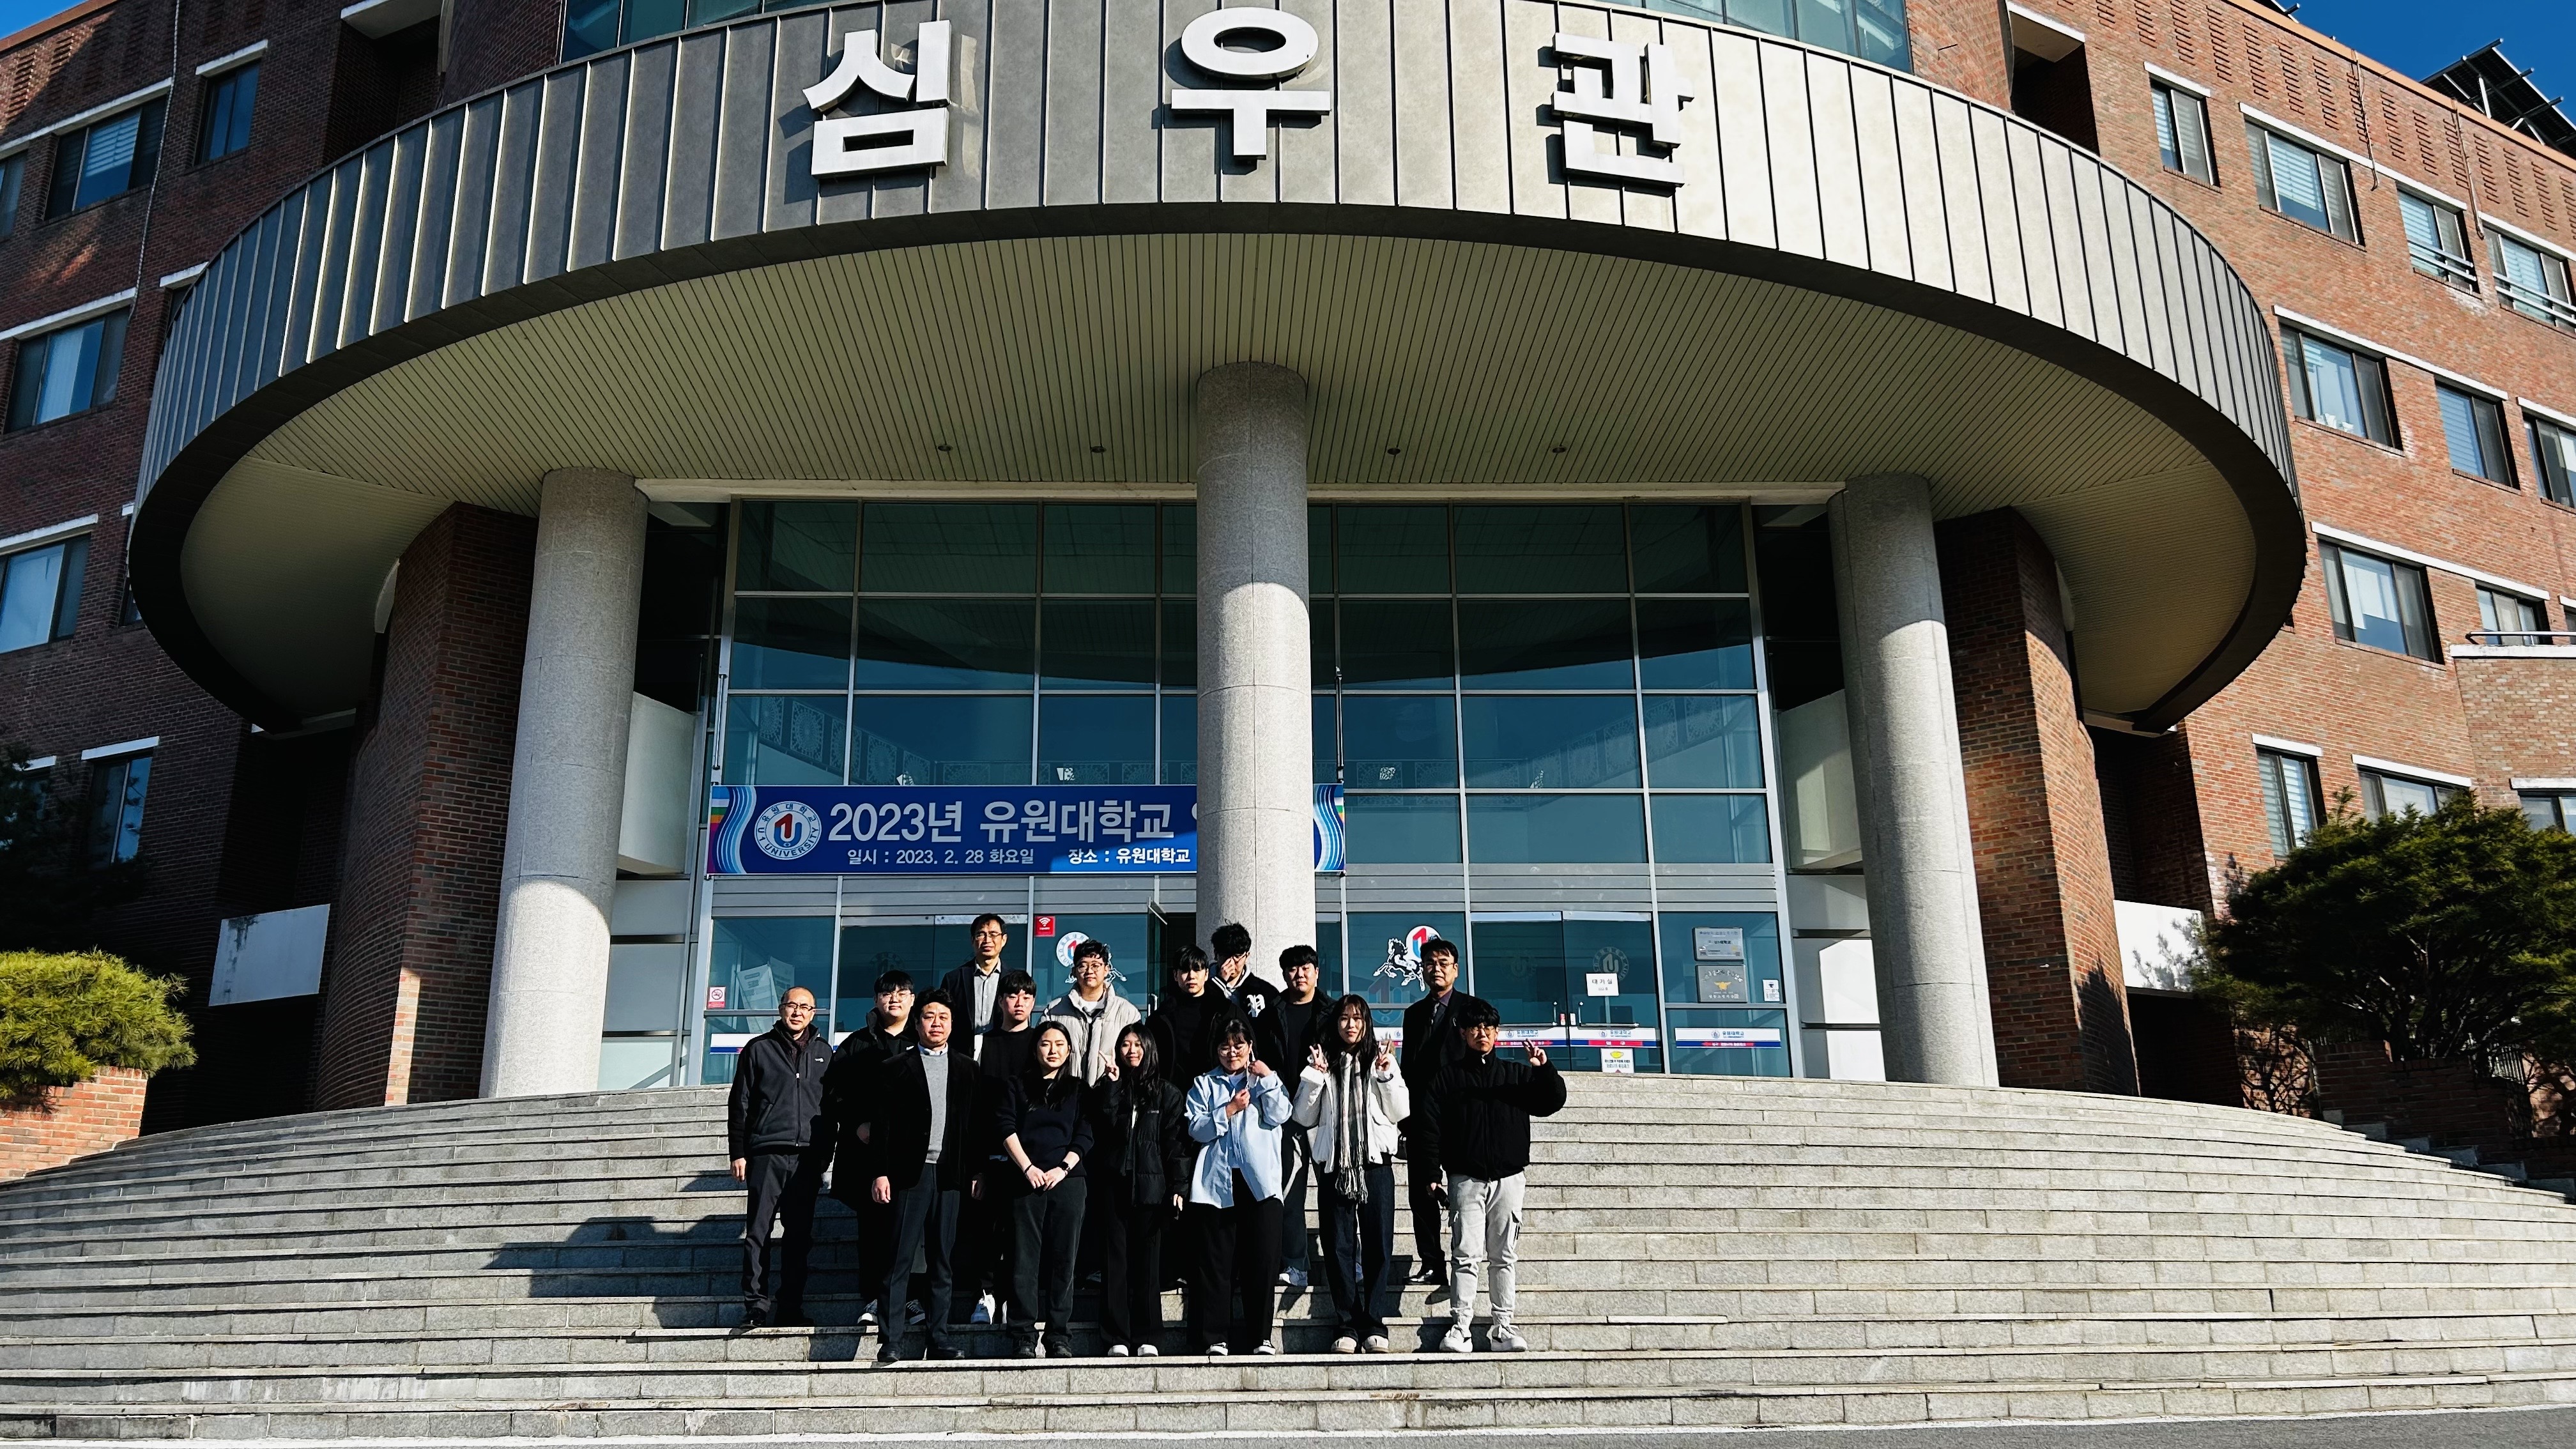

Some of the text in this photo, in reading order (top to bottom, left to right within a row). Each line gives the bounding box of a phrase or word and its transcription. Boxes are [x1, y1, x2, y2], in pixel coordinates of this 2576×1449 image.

[762, 802, 816, 822] 유원대학교
[828, 801, 962, 843] 2023년
[979, 800, 1174, 843] 유원대학교
[764, 827, 820, 857] UNIVERSITY
[847, 849, 877, 865] 일시
[896, 849, 938, 864] 2023.
[944, 849, 959, 864] 2.
[965, 849, 984, 864] 28
[988, 848, 1034, 865] 화요일
[1068, 848, 1098, 864] 장소
[1116, 848, 1191, 864] 유원대학교
